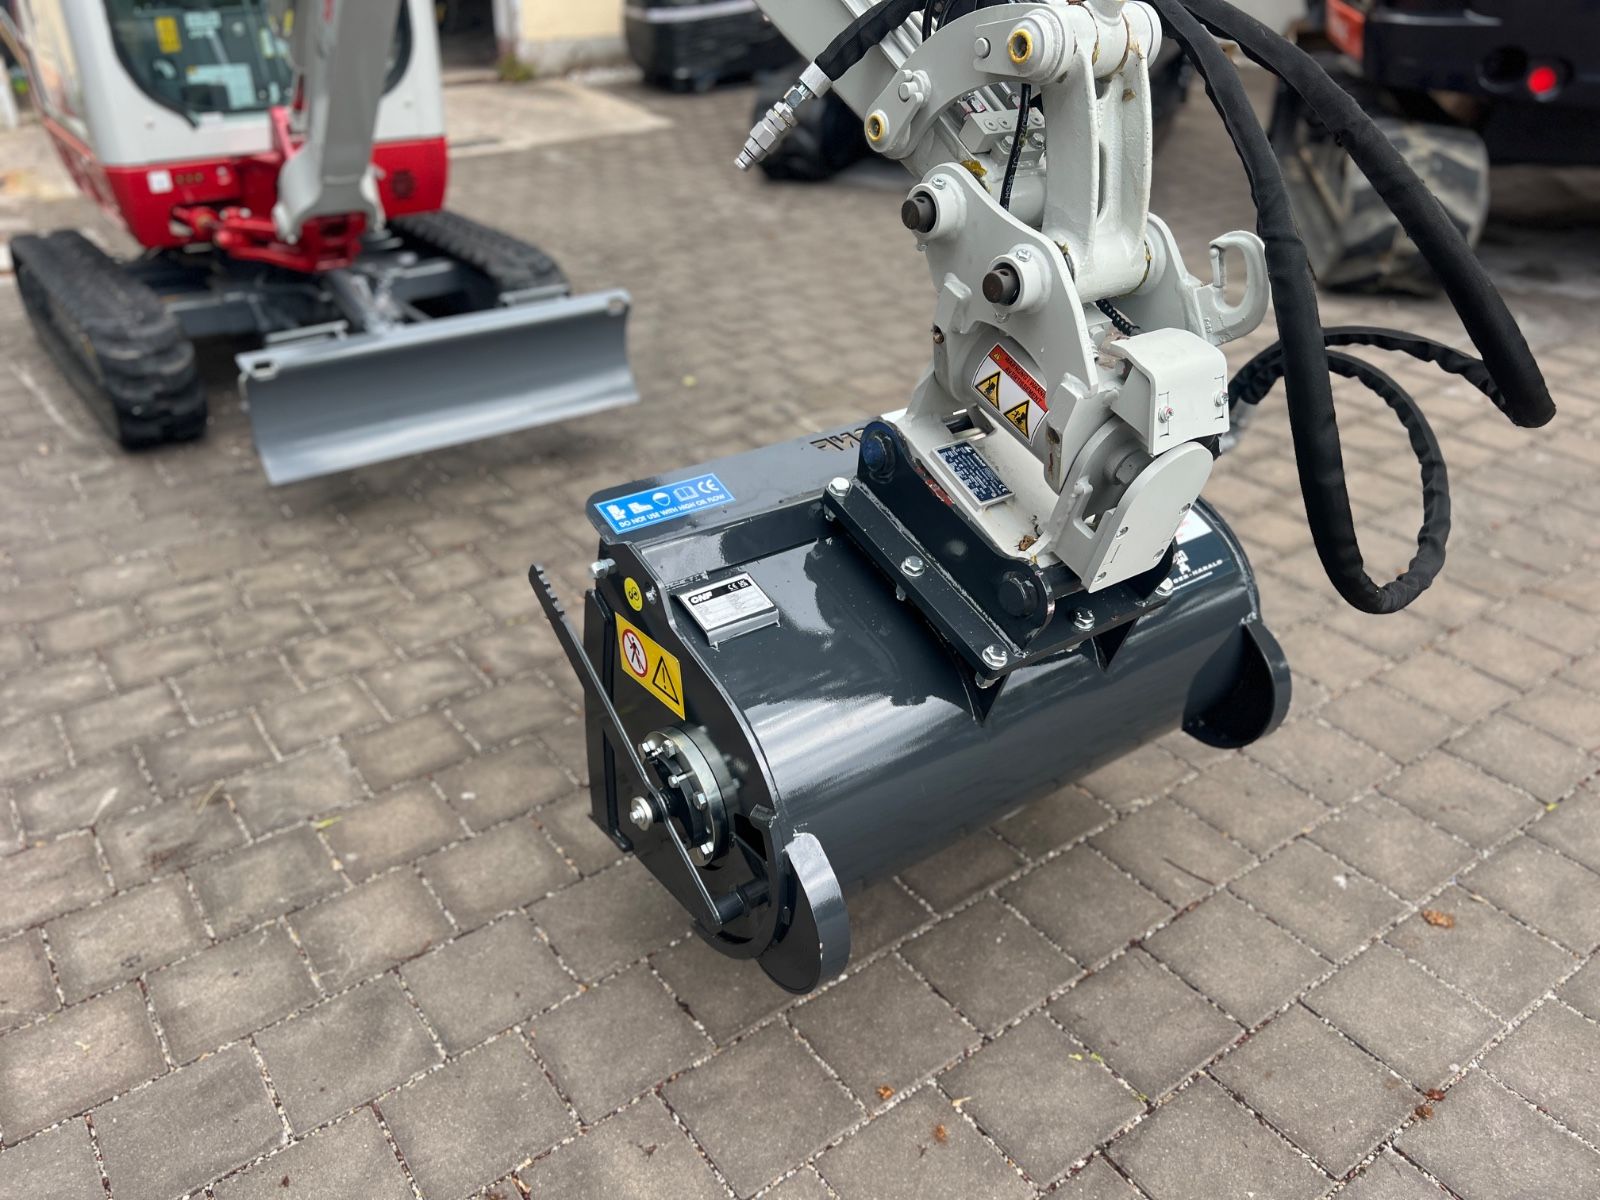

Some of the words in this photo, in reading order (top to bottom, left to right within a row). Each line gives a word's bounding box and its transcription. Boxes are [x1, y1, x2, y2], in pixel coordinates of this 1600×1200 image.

[618, 520, 632, 528] DO
[632, 516, 647, 525] NOT
[646, 513, 661, 521] USE
[660, 506, 678, 517] WITH
[678, 502, 696, 512] HIGH
[696, 498, 707, 507] OIL
[707, 494, 726, 504] FLOW
[690, 591, 713, 604] CNF
